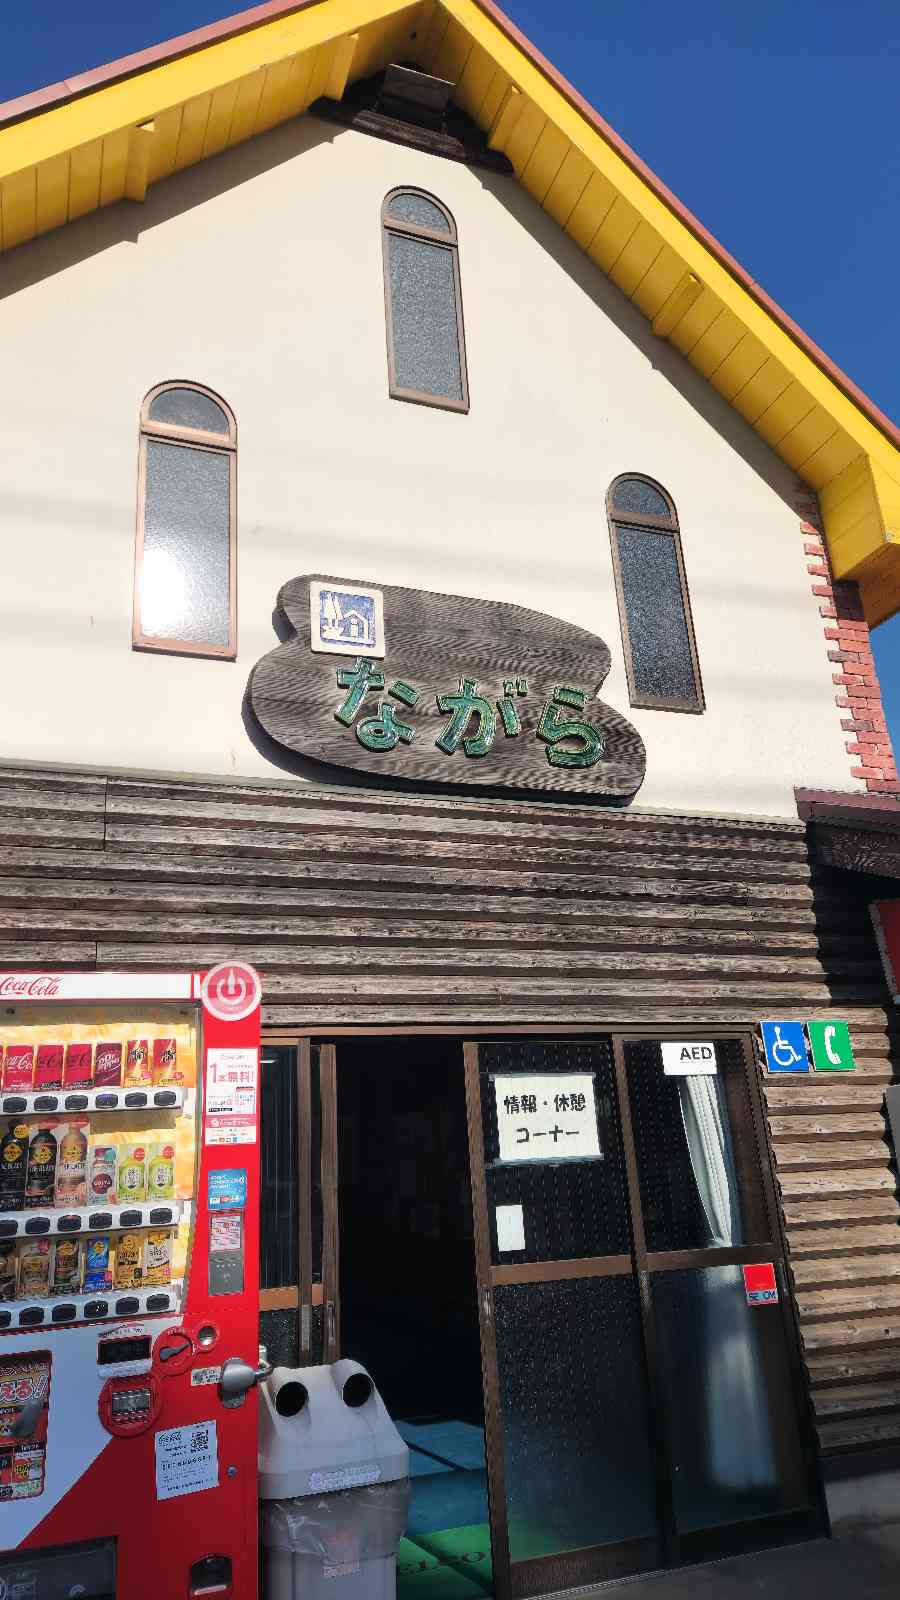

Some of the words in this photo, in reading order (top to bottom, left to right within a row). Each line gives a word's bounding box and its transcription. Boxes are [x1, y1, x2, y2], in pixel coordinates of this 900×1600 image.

[334, 657, 607, 769] ながら
[0, 976, 64, 995] Coca-Cola
[680, 1046, 712, 1060] AED
[504, 1093, 586, 1114] 情報・休憩
[516, 1124, 579, 1143] コーナー
